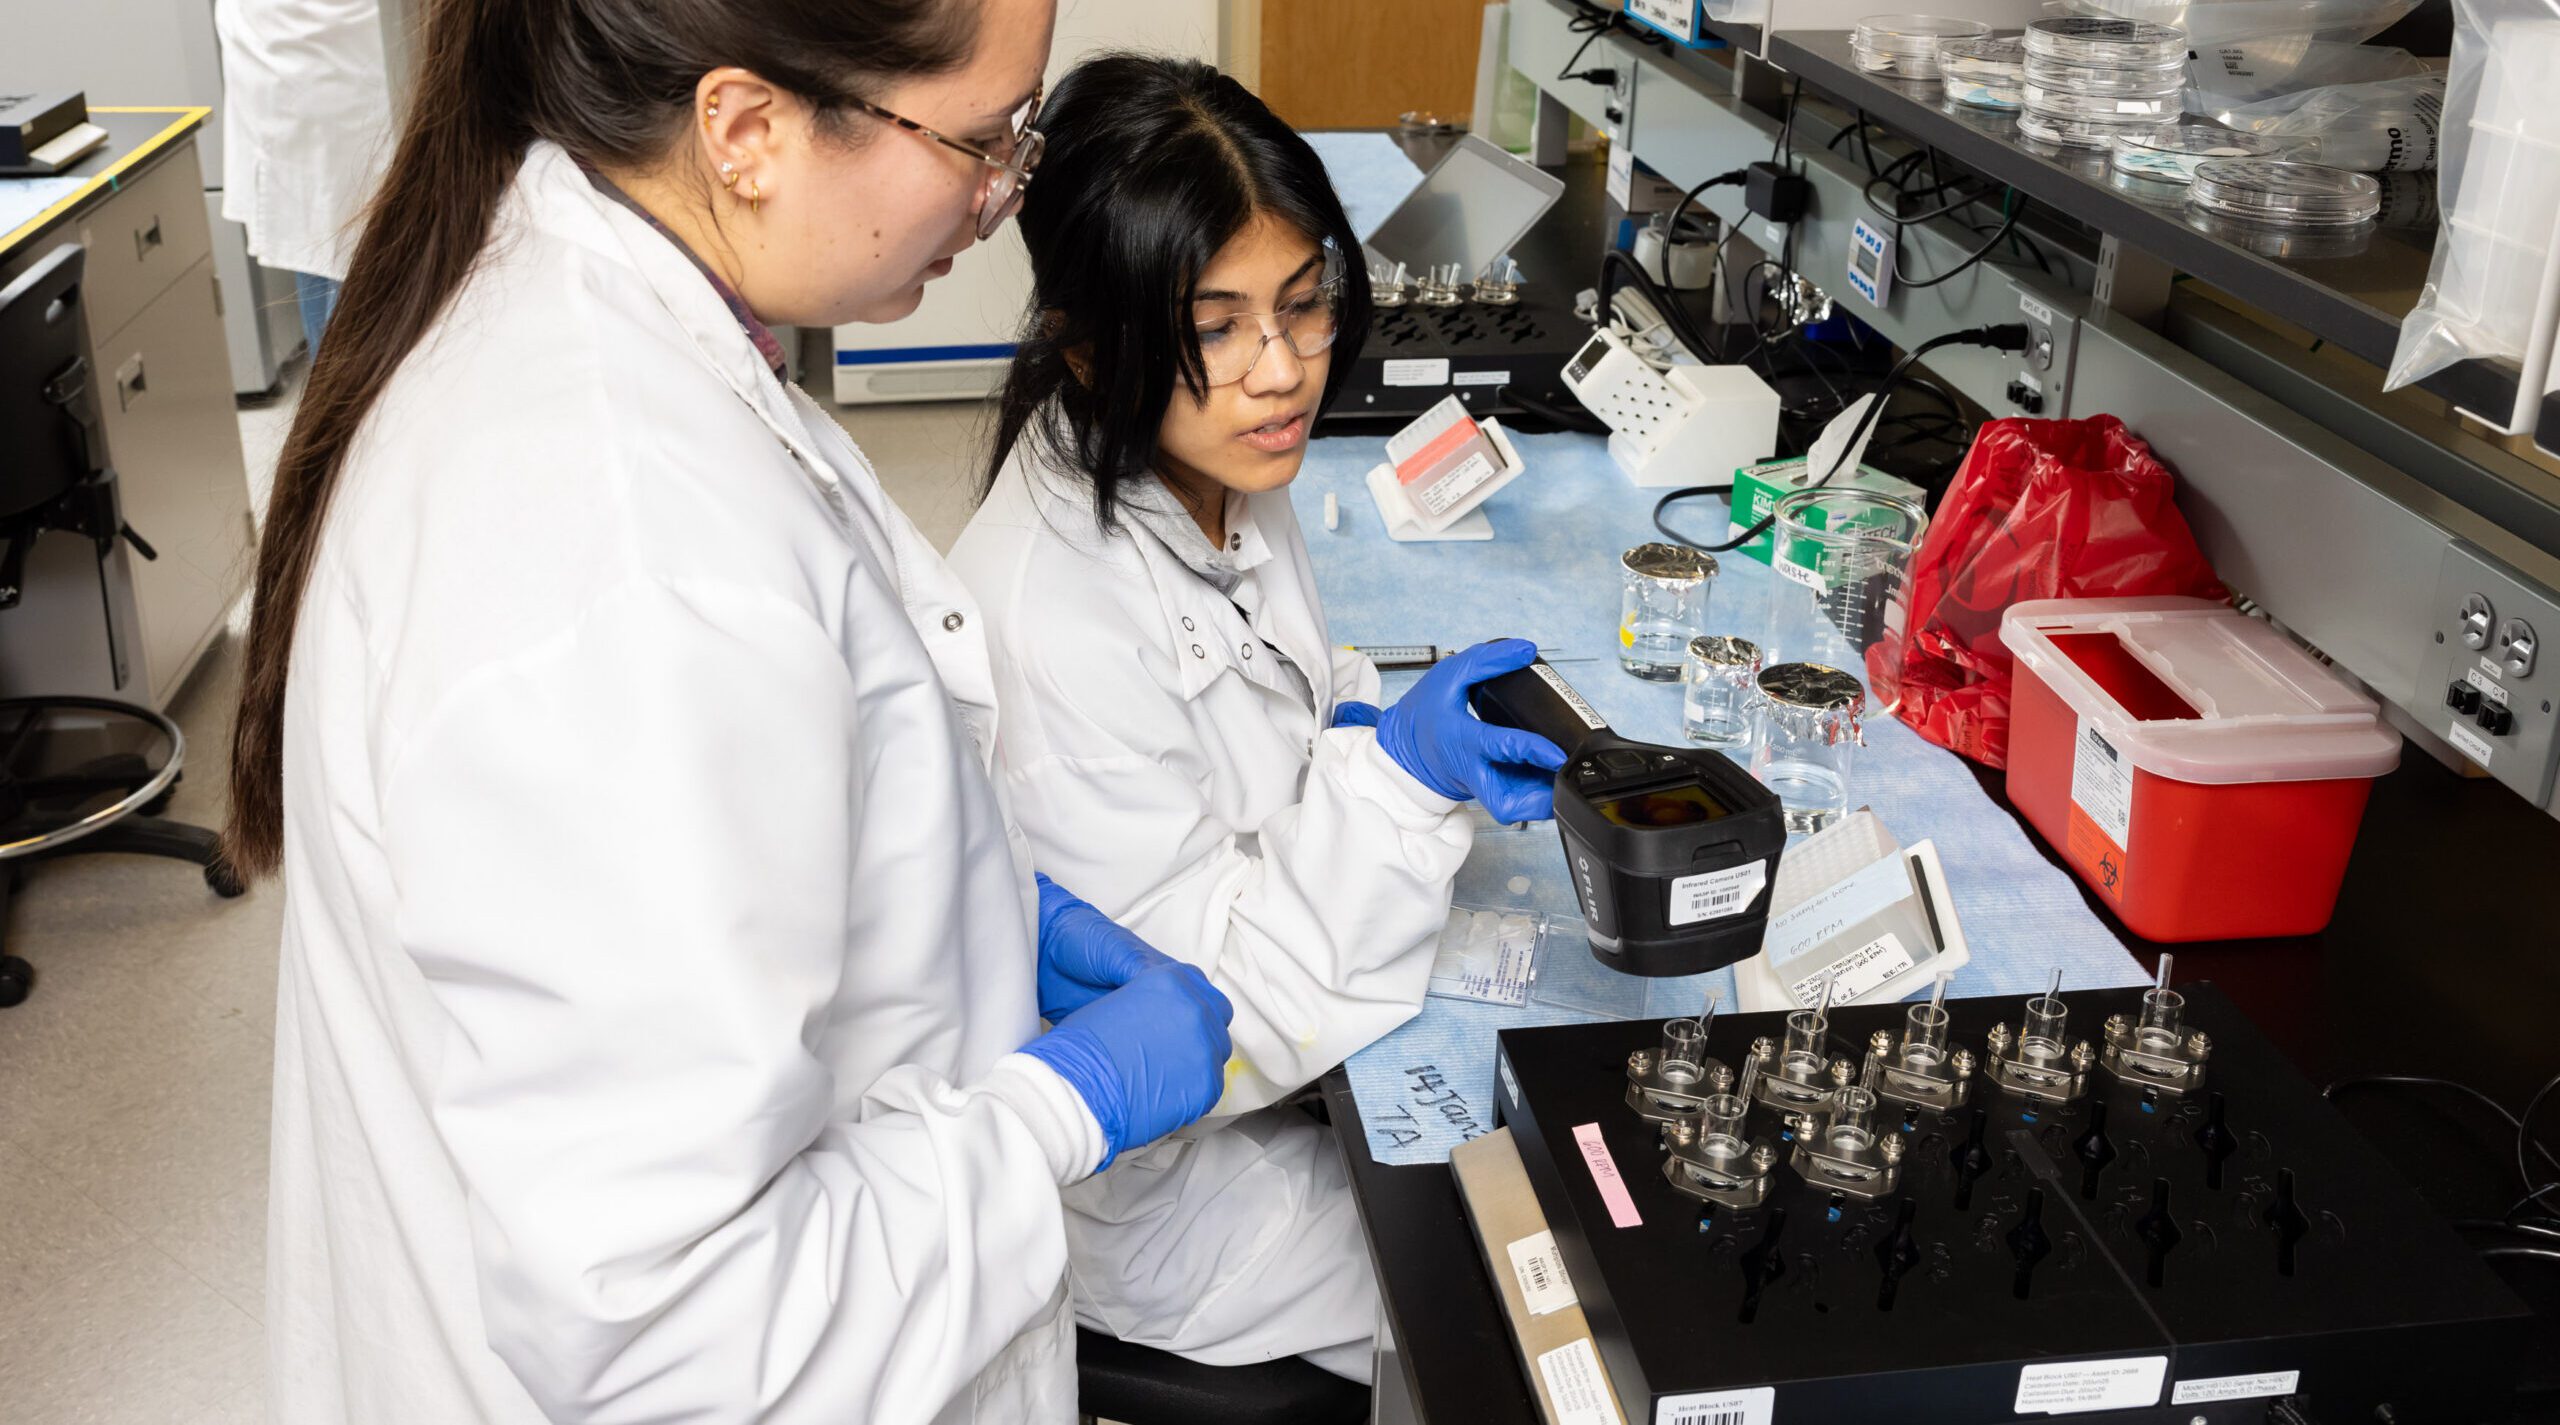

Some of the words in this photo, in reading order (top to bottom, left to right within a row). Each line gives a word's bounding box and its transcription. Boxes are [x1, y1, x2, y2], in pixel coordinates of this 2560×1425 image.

[1682, 880, 1709, 889] Infrared
[1709, 875, 1734, 885] Camera
[1583, 873, 1599, 922] FLIR
[1790, 938, 1812, 956] 600
[1816, 918, 1844, 941] RPM
[2024, 1381, 2062, 1389] Calibration
[2022, 1389, 2060, 1397] Calibration
